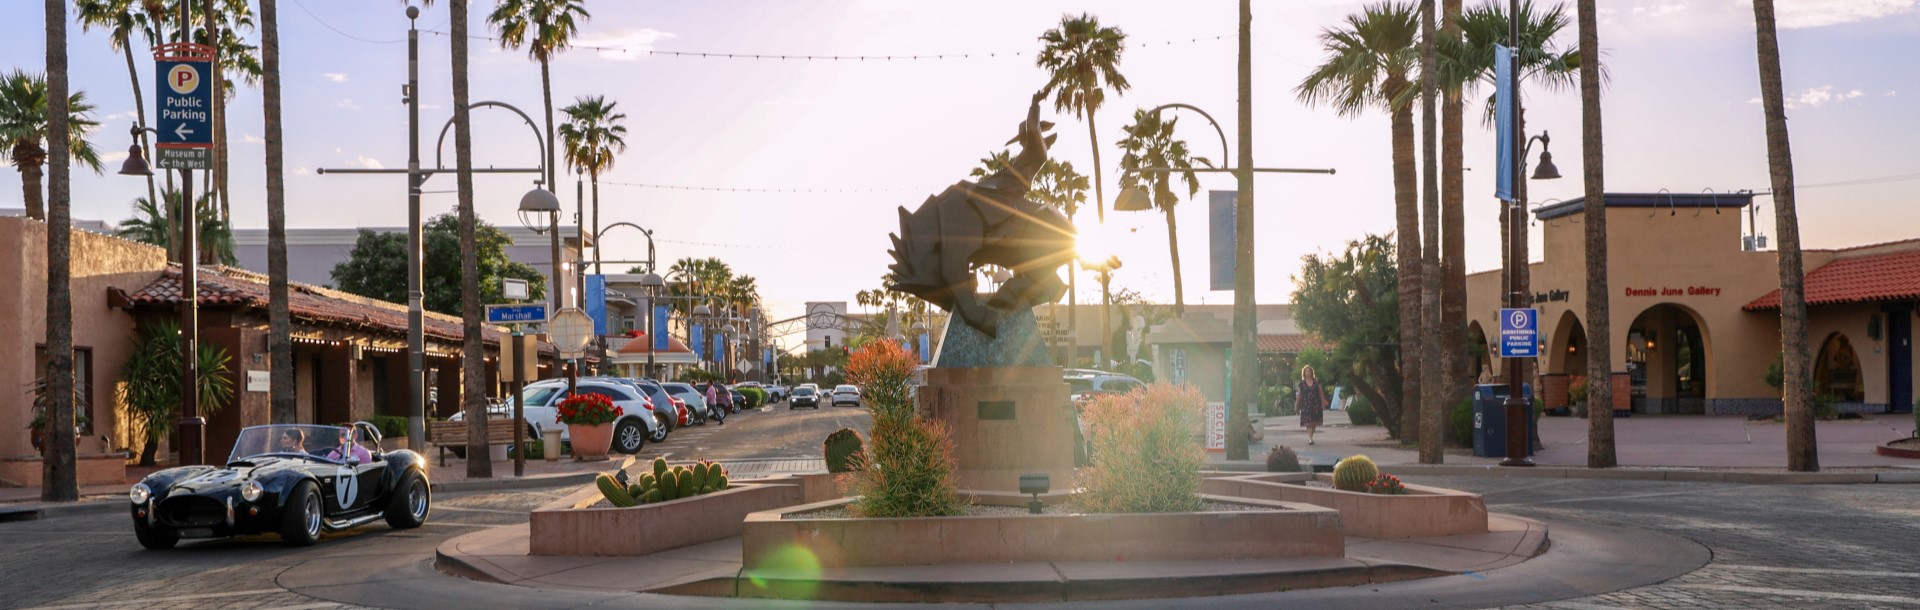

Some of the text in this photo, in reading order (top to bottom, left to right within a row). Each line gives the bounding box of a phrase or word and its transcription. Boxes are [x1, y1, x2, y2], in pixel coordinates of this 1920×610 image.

[177, 71, 193, 87] P
[166, 96, 202, 107] Public
[162, 109, 206, 122] Parking
[164, 149, 205, 158] Museum of
[172, 159, 205, 168] the West
[1549, 289, 1569, 303] Gallery
[1625, 286, 1721, 297] Dennis June Gallery
[501, 312, 532, 320] Marshall
[1515, 314, 1524, 326] P
[1215, 405, 1224, 448] SOCIAL
[340, 475, 352, 504] 7
